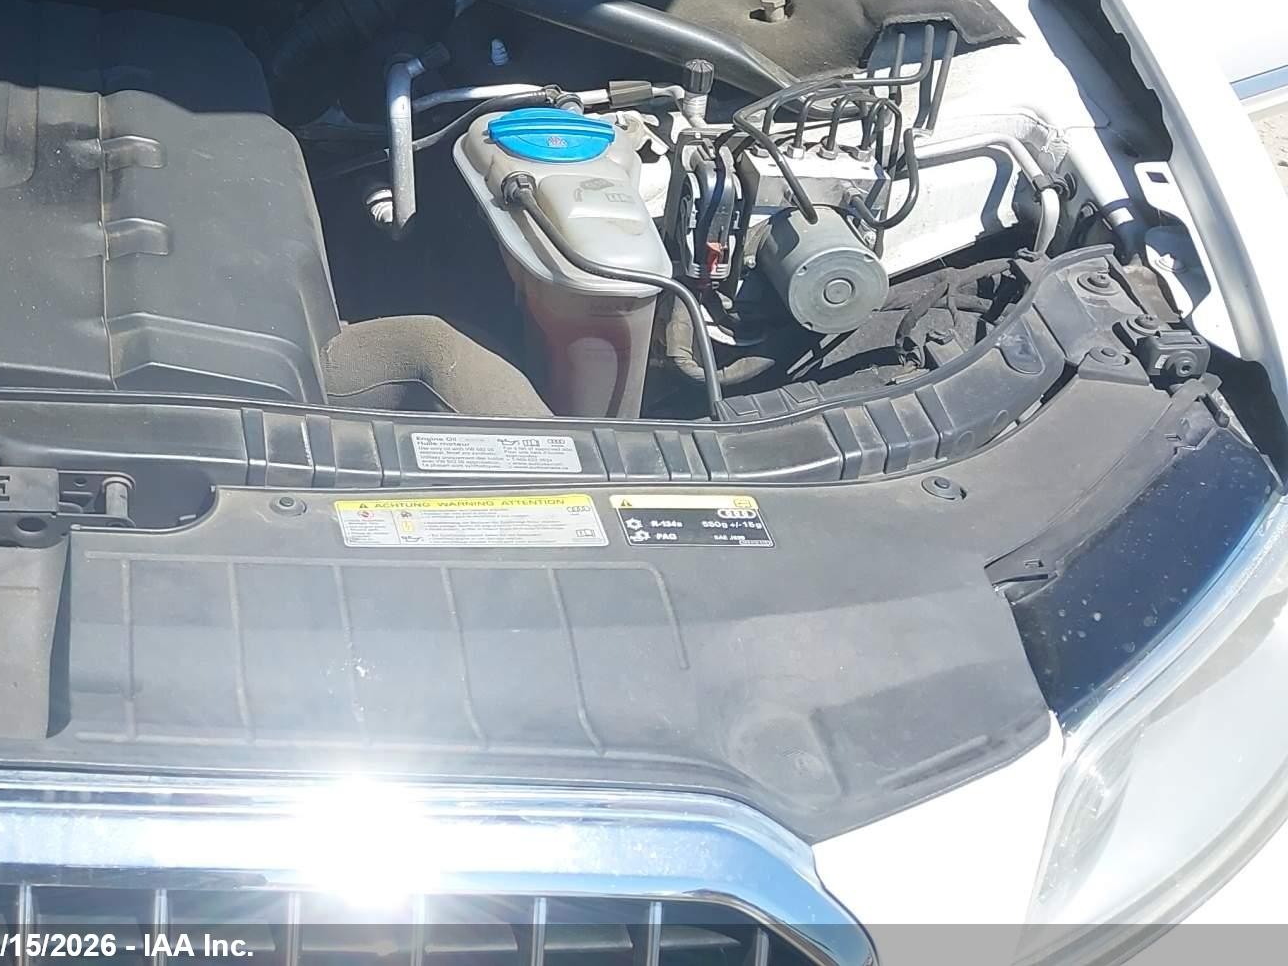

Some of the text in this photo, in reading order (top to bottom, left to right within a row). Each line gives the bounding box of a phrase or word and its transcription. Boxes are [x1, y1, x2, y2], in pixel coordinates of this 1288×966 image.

[374, 498, 565, 508] ACHTUNG WARNING ATTENTION
[650, 520, 683, 528] R-134a
[656, 533, 678, 541] PAG
